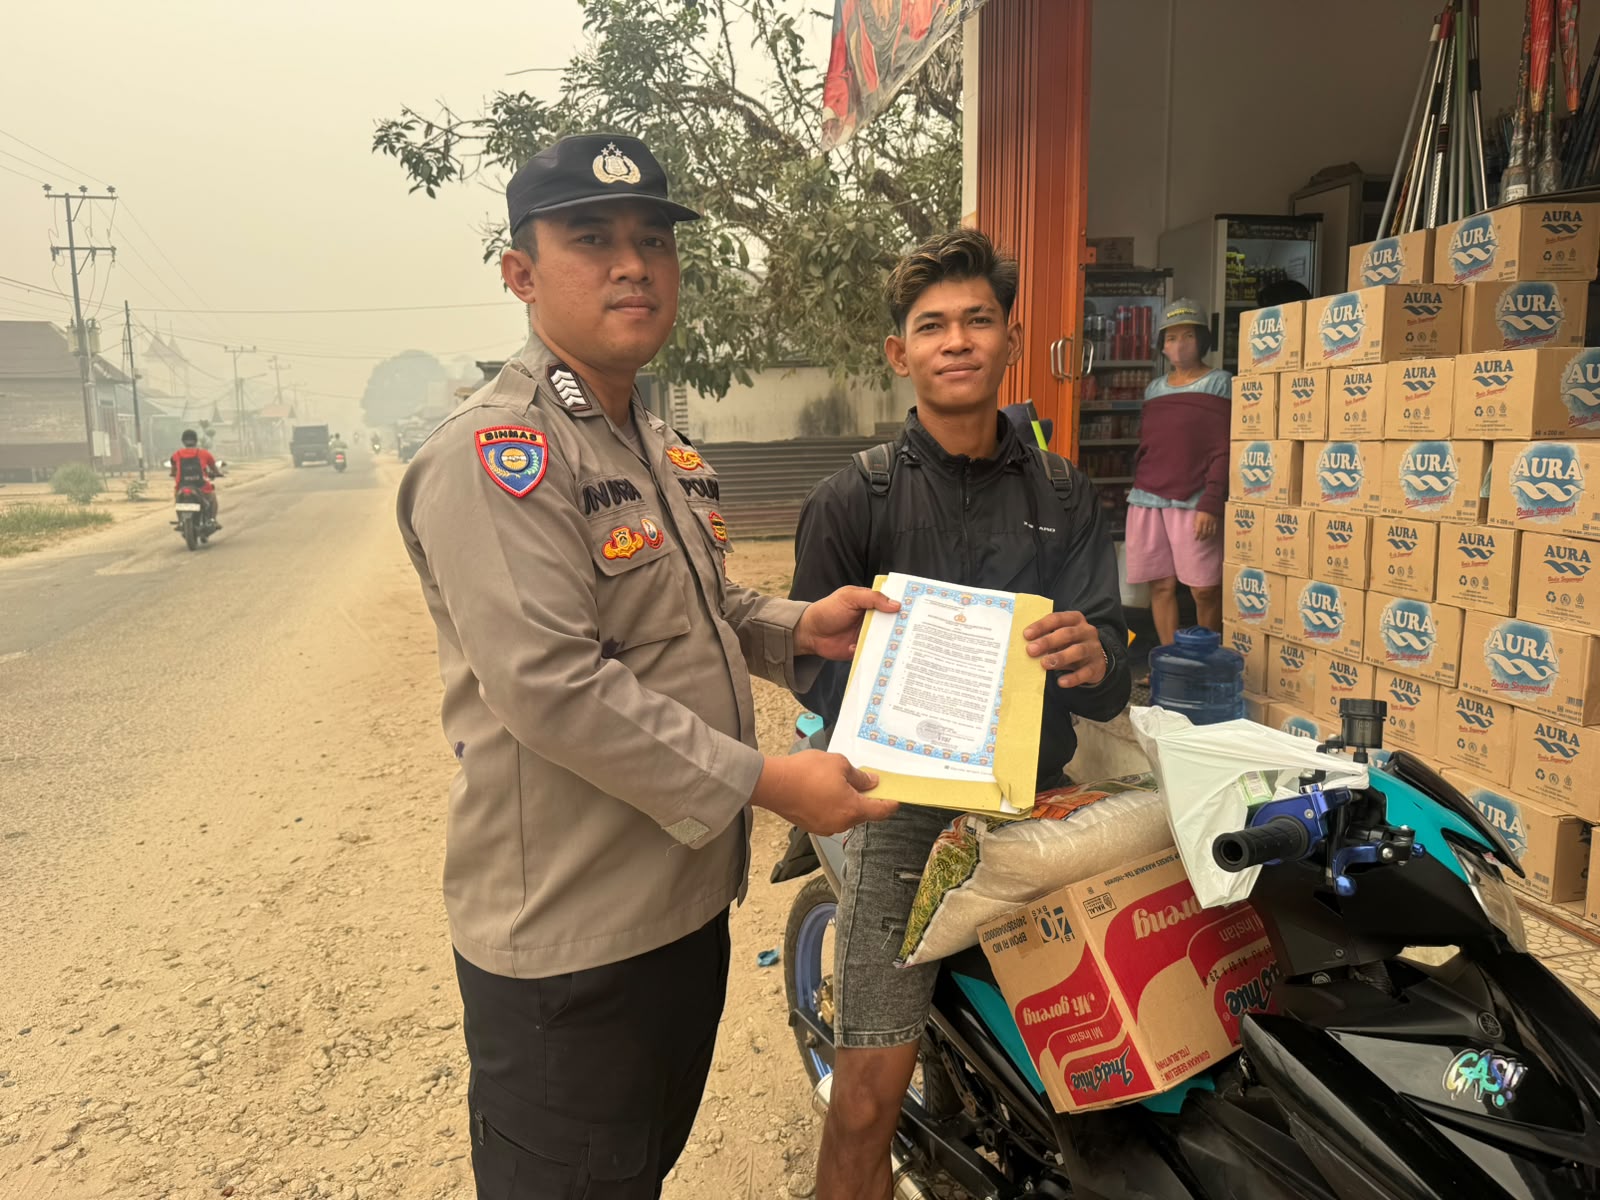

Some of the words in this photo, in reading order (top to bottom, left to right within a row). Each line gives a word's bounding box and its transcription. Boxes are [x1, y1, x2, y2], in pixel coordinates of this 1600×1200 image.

[1542, 210, 1583, 222] AURA
[1452, 224, 1497, 250] AURA
[1364, 245, 1404, 268] AURA
[1403, 292, 1442, 304] AURA
[1501, 293, 1562, 312] AURA
[1322, 303, 1364, 325] AURA
[1250, 317, 1284, 336] AURA
[1403, 366, 1437, 379] AURA
[1473, 359, 1514, 374] AURA
[1567, 363, 1600, 384] AU
[1241, 381, 1263, 392] AURA
[1291, 377, 1315, 388] AURA
[1343, 372, 1373, 386] AURA
[485, 430, 537, 442] BINMAS
[1241, 451, 1273, 467] AURA
[1320, 452, 1363, 470] AURA
[1403, 453, 1457, 473] AURA
[1514, 456, 1584, 482] AURA
[1234, 509, 1255, 520] AURA
[1275, 513, 1298, 526] AURA
[1326, 520, 1353, 533] AURA
[1387, 525, 1418, 540] AURA
[1457, 532, 1496, 548] AURA
[1543, 544, 1591, 563] AURA
[1236, 577, 1268, 595] AURA
[1301, 591, 1343, 614] AURA
[1383, 607, 1434, 634] AURA
[1232, 631, 1252, 645] AURA
[1489, 630, 1558, 664] AURA
[1280, 645, 1305, 660] AURA
[1329, 660, 1358, 678] AURA
[1389, 676, 1422, 696] AURA
[1456, 696, 1495, 719] AURA
[1281, 721, 1319, 740] AUR
[1534, 723, 1580, 747] AURA
[1469, 797, 1526, 838] URA
[1031, 905, 1048, 917] BKS
[1088, 903, 1106, 914] HALAL
[1034, 906, 1073, 944] 40
[1132, 896, 1203, 940] oreng
[1219, 915, 1258, 942] Instan
[1010, 931, 1028, 948] BPOM
[1060, 933, 1076, 944] ISI
[1023, 995, 1070, 1025] goreng
[1071, 992, 1095, 1017] Mi
[1066, 1030, 1093, 1043] Instan
[1092, 1026, 1104, 1039] Mi
